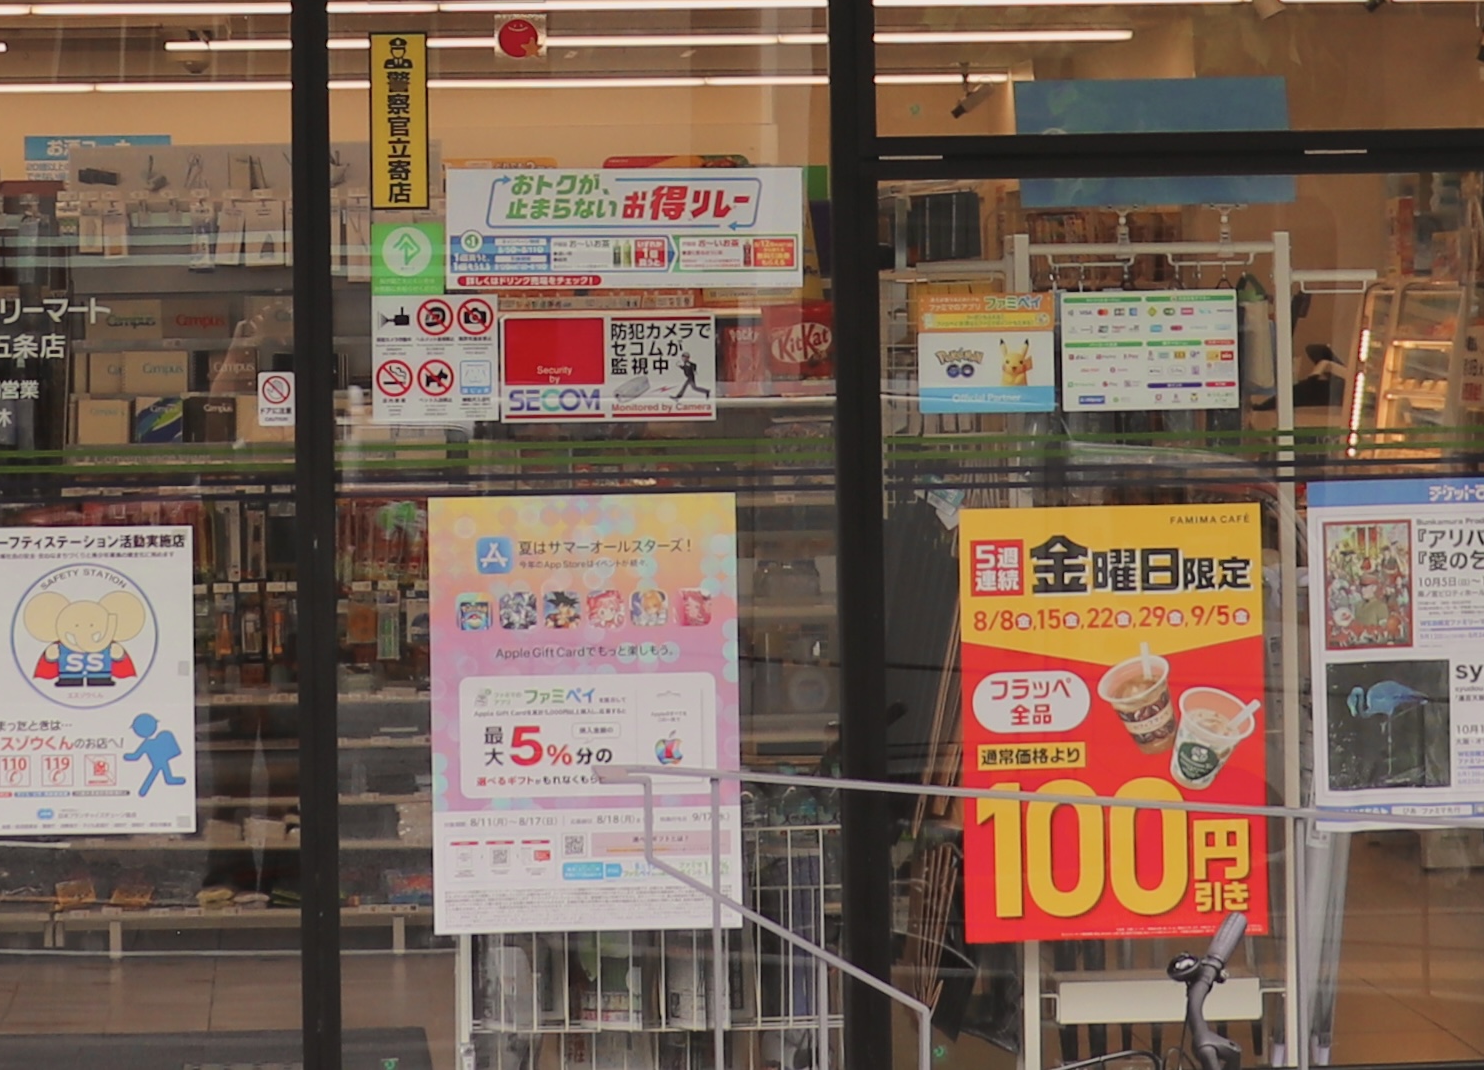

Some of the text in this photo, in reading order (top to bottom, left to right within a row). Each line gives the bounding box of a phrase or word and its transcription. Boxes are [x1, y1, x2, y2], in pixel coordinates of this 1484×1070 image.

[387, 70, 412, 203] 警察官立寄店
[510, 173, 611, 196] おトクが、
[505, 197, 617, 220] 止まらない
[621, 185, 751, 221] お得リレー
[983, 295, 1042, 310] ファミペイ
[106, 314, 156, 329] Campus
[175, 313, 226, 328] Campus
[611, 322, 711, 341] 防犯カメラで
[611, 340, 684, 358] セコムが
[777, 324, 831, 363] KitKat
[142, 363, 184, 376] Campus
[537, 365, 573, 377] Security
[611, 358, 670, 376] 監視中
[549, 375, 561, 385] by
[509, 388, 602, 412] SECOM
[952, 393, 1022, 402] Official Partner
[611, 402, 712, 413] Monitored by Camera
[1170, 515, 1217, 525] FAMIMA
[975, 544, 1020, 568] 5週
[1030, 535, 1253, 594] 金曜日限定
[40, 568, 128, 590] SAFETY STATION
[975, 568, 1020, 592] 連続
[496, 647, 531, 659] Apple
[532, 647, 555, 658] Gift
[66, 653, 105, 672] SS
[524, 688, 596, 704] ファミペイ
[990, 677, 1072, 700] フラッペ
[1010, 703, 1053, 726] 全品
[1, 758, 28, 772] 110
[44, 757, 71, 771] 119
[981, 748, 1081, 766] 通常価格より
[977, 777, 1189, 919] 100
